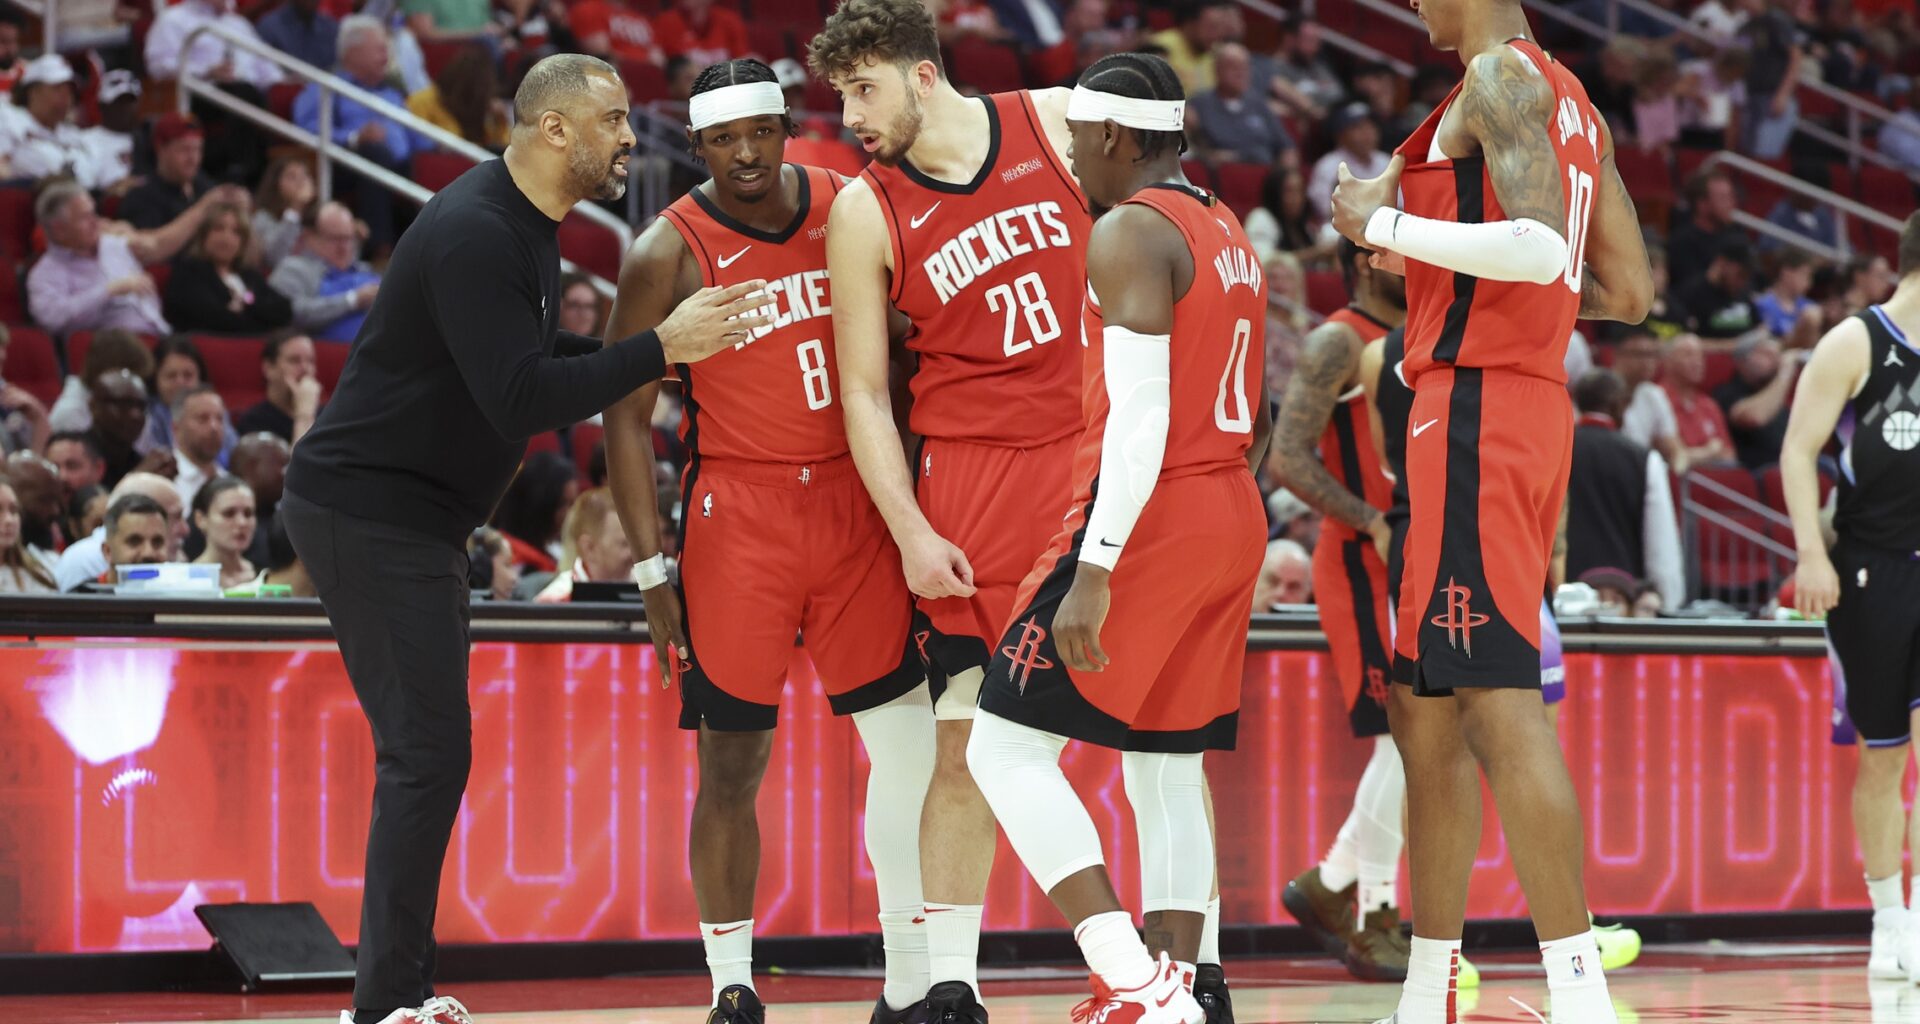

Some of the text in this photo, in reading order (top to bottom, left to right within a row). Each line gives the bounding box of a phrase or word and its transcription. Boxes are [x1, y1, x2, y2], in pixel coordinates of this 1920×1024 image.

[923, 201, 1072, 306] ROCKETS
[1213, 245, 1262, 298] HOLIDAY
[1564, 163, 1593, 294] 10
[984, 271, 1062, 358] 28
[796, 338, 832, 411] 8
[1214, 317, 1252, 434] 0
